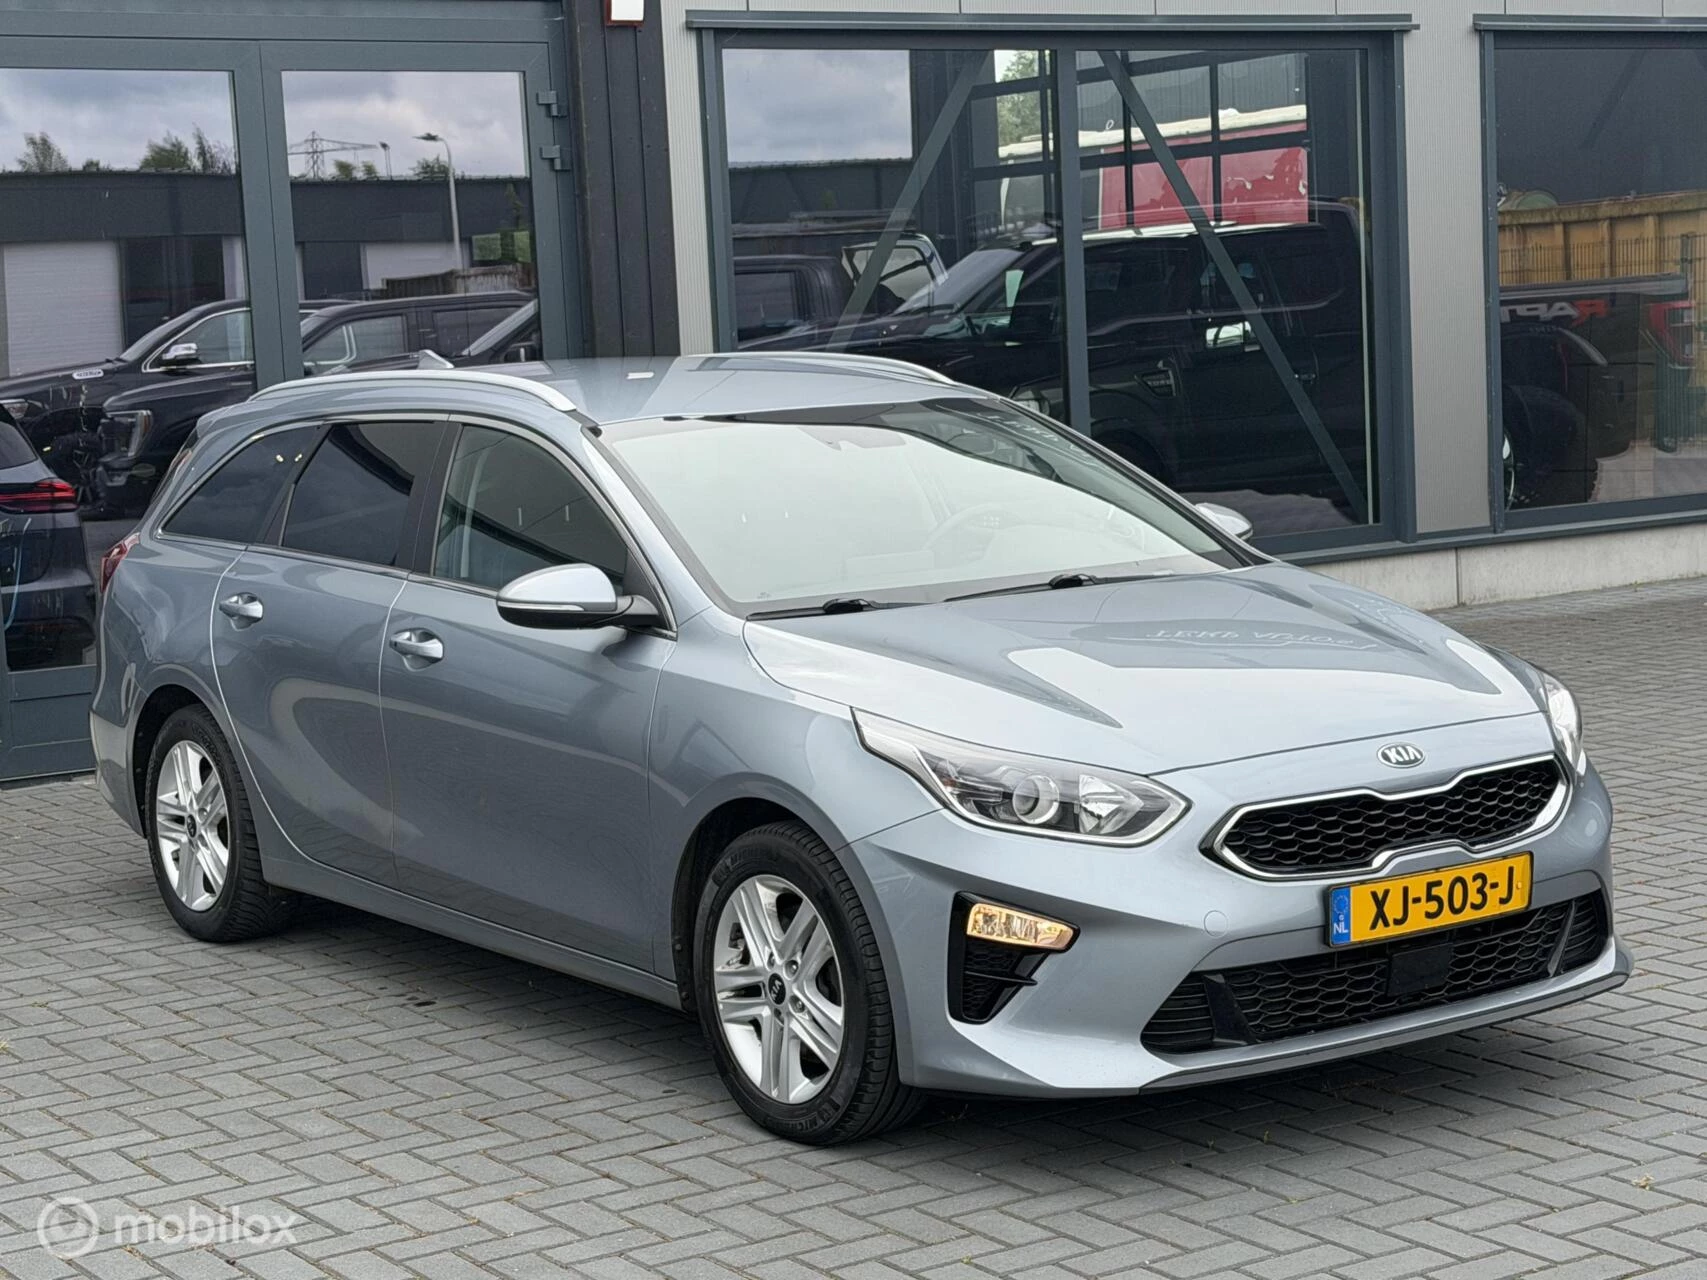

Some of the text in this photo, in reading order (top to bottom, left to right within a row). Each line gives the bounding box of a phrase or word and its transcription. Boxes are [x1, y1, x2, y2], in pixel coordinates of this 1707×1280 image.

[1383, 745, 1422, 764] KIA
[1369, 865, 1515, 931] XJ-503-J
[1333, 922, 1350, 935] NL
